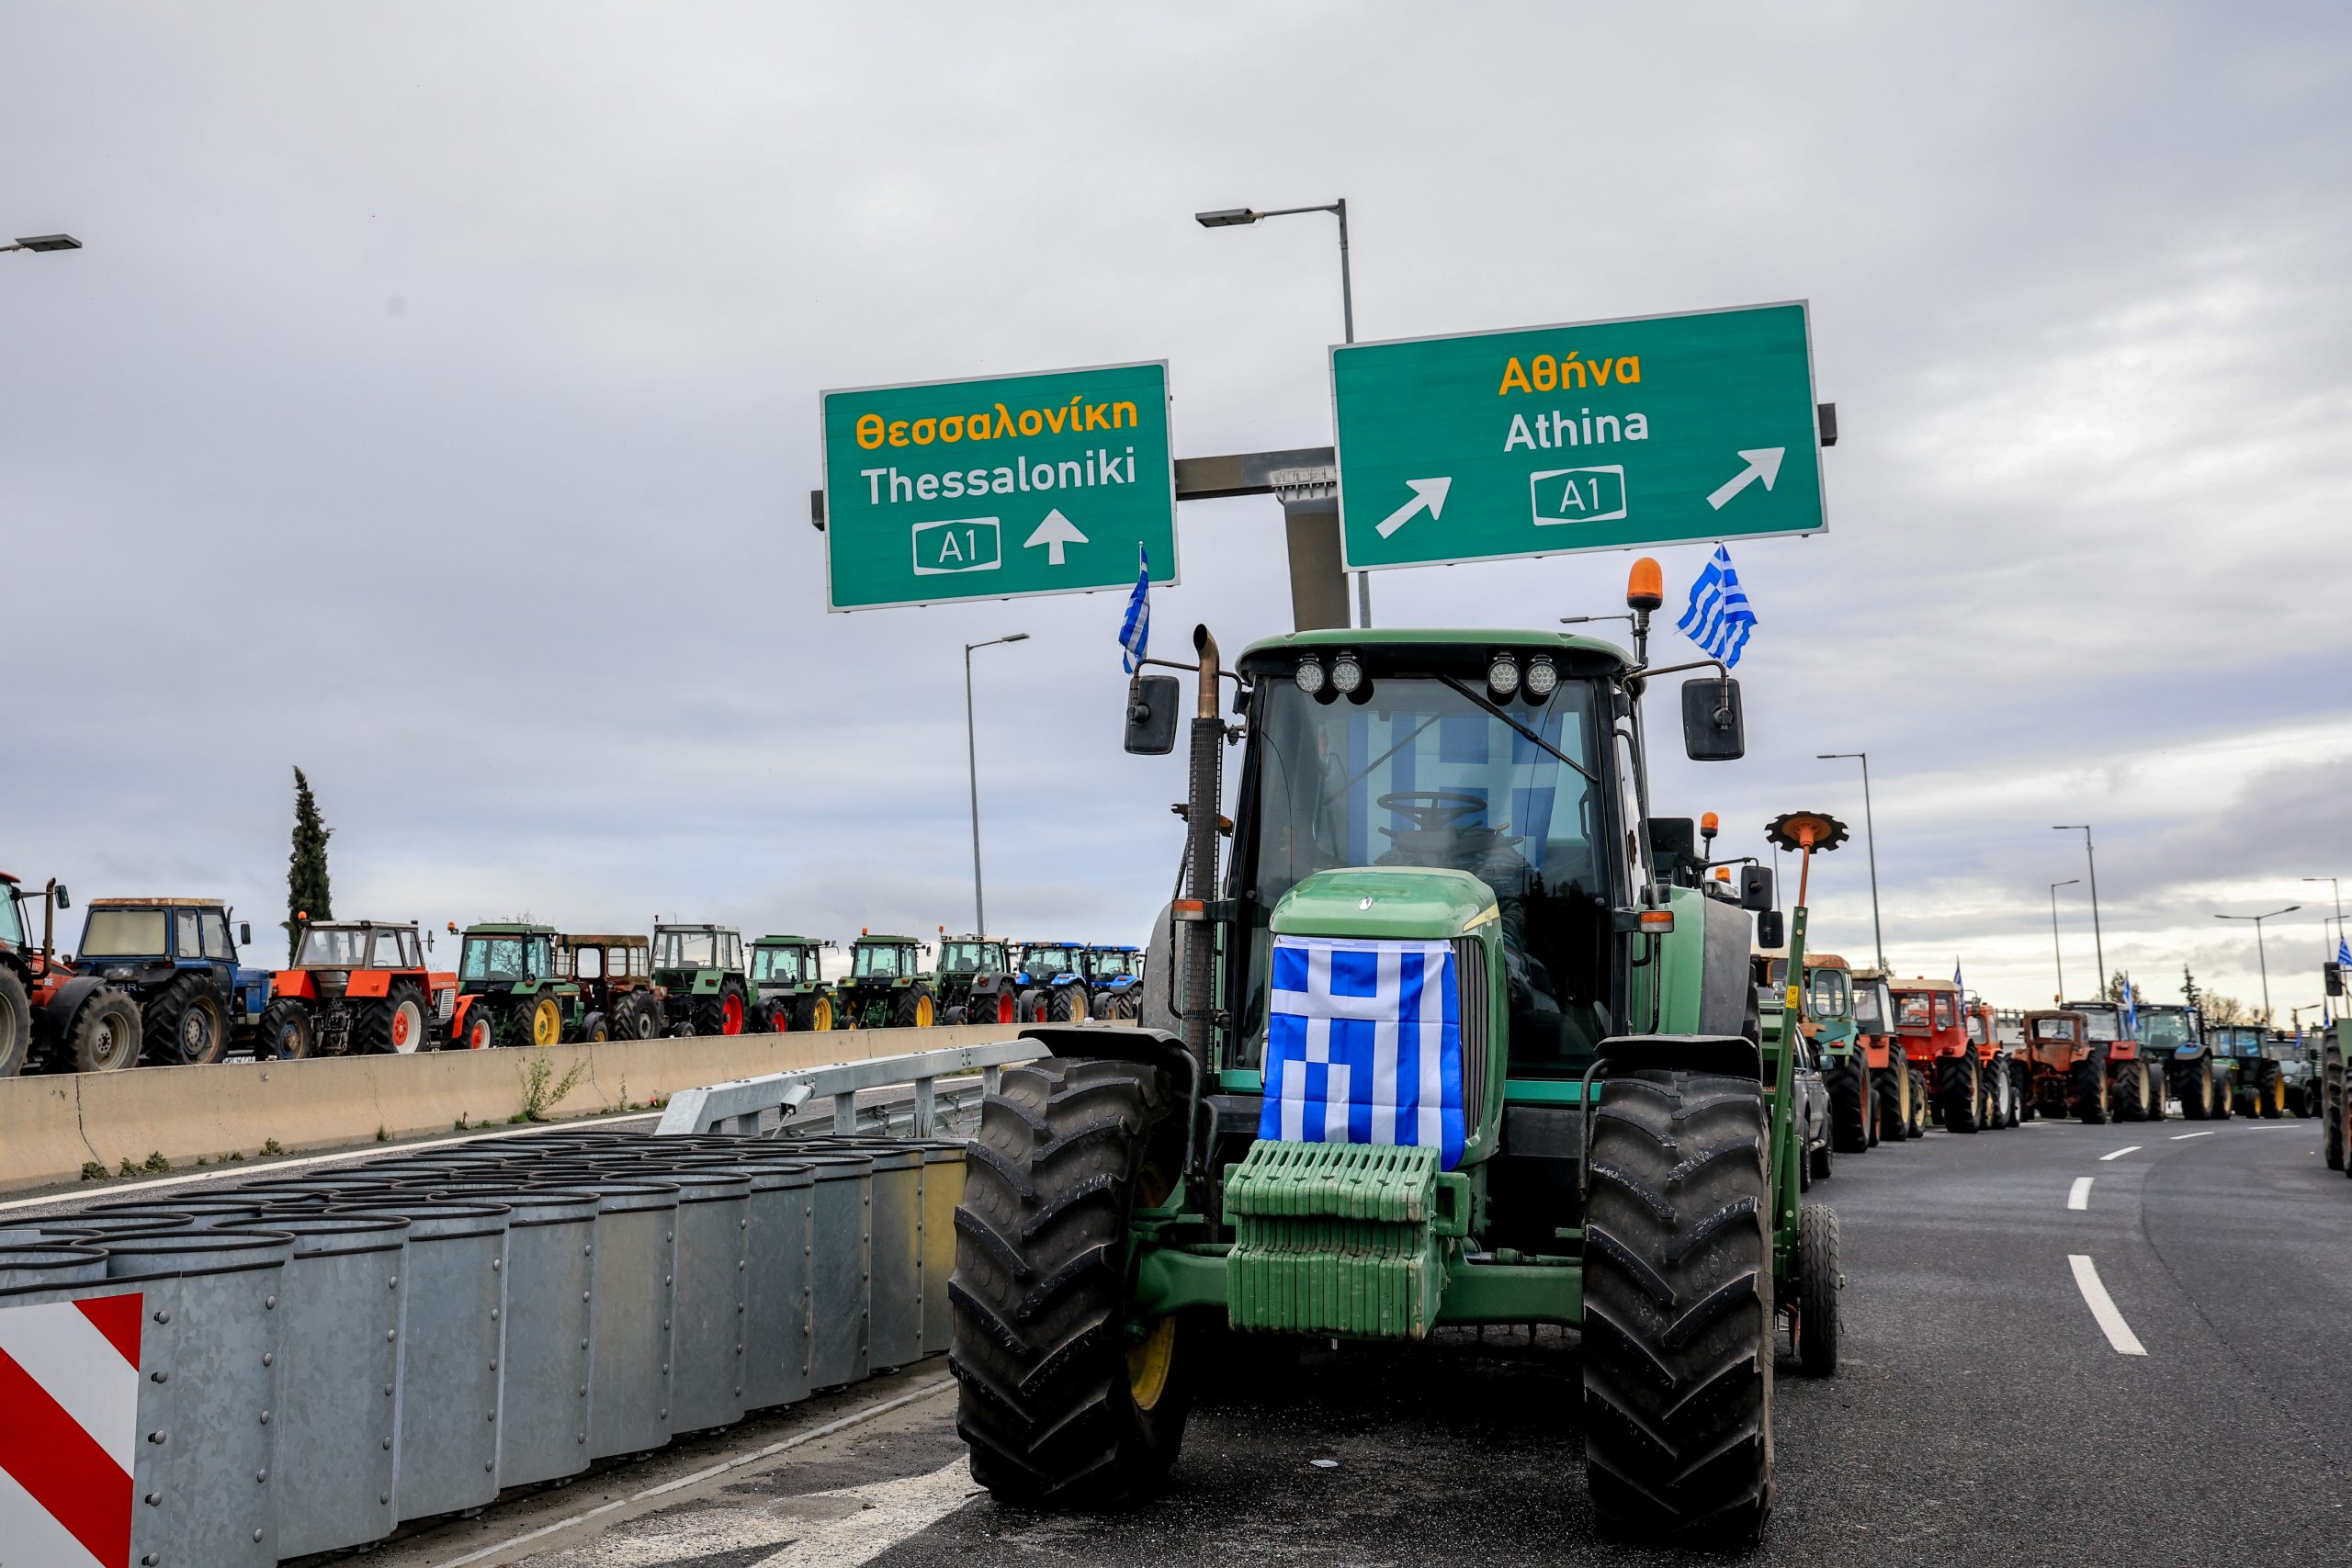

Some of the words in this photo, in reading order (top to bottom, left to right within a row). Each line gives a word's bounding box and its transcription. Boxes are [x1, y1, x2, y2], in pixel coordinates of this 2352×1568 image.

[1498, 351, 1641, 396] Αθήνα
[856, 395, 1137, 449] Θεσσαλονίκη
[1503, 407, 1648, 452] Athina
[861, 446, 1136, 505] Thessaloniki
[1559, 478, 1600, 513] A1
[938, 529, 976, 563] A1
